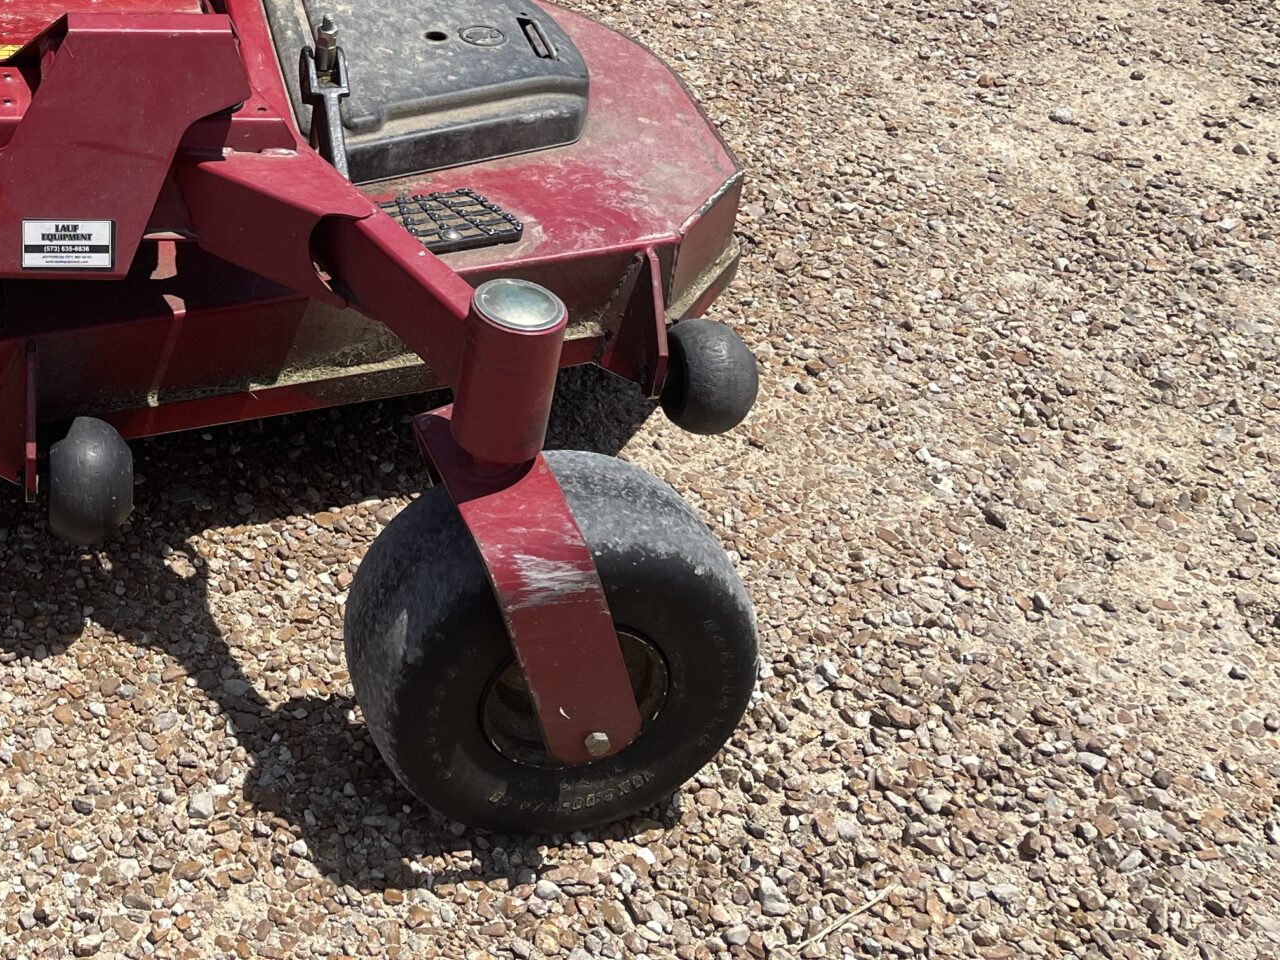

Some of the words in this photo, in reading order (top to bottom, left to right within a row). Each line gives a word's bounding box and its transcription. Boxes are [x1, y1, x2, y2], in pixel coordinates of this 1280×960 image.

[54, 224, 80, 233] LAUF
[40, 233, 93, 242] EQUIPMENT
[43, 245, 60, 253] (573)
